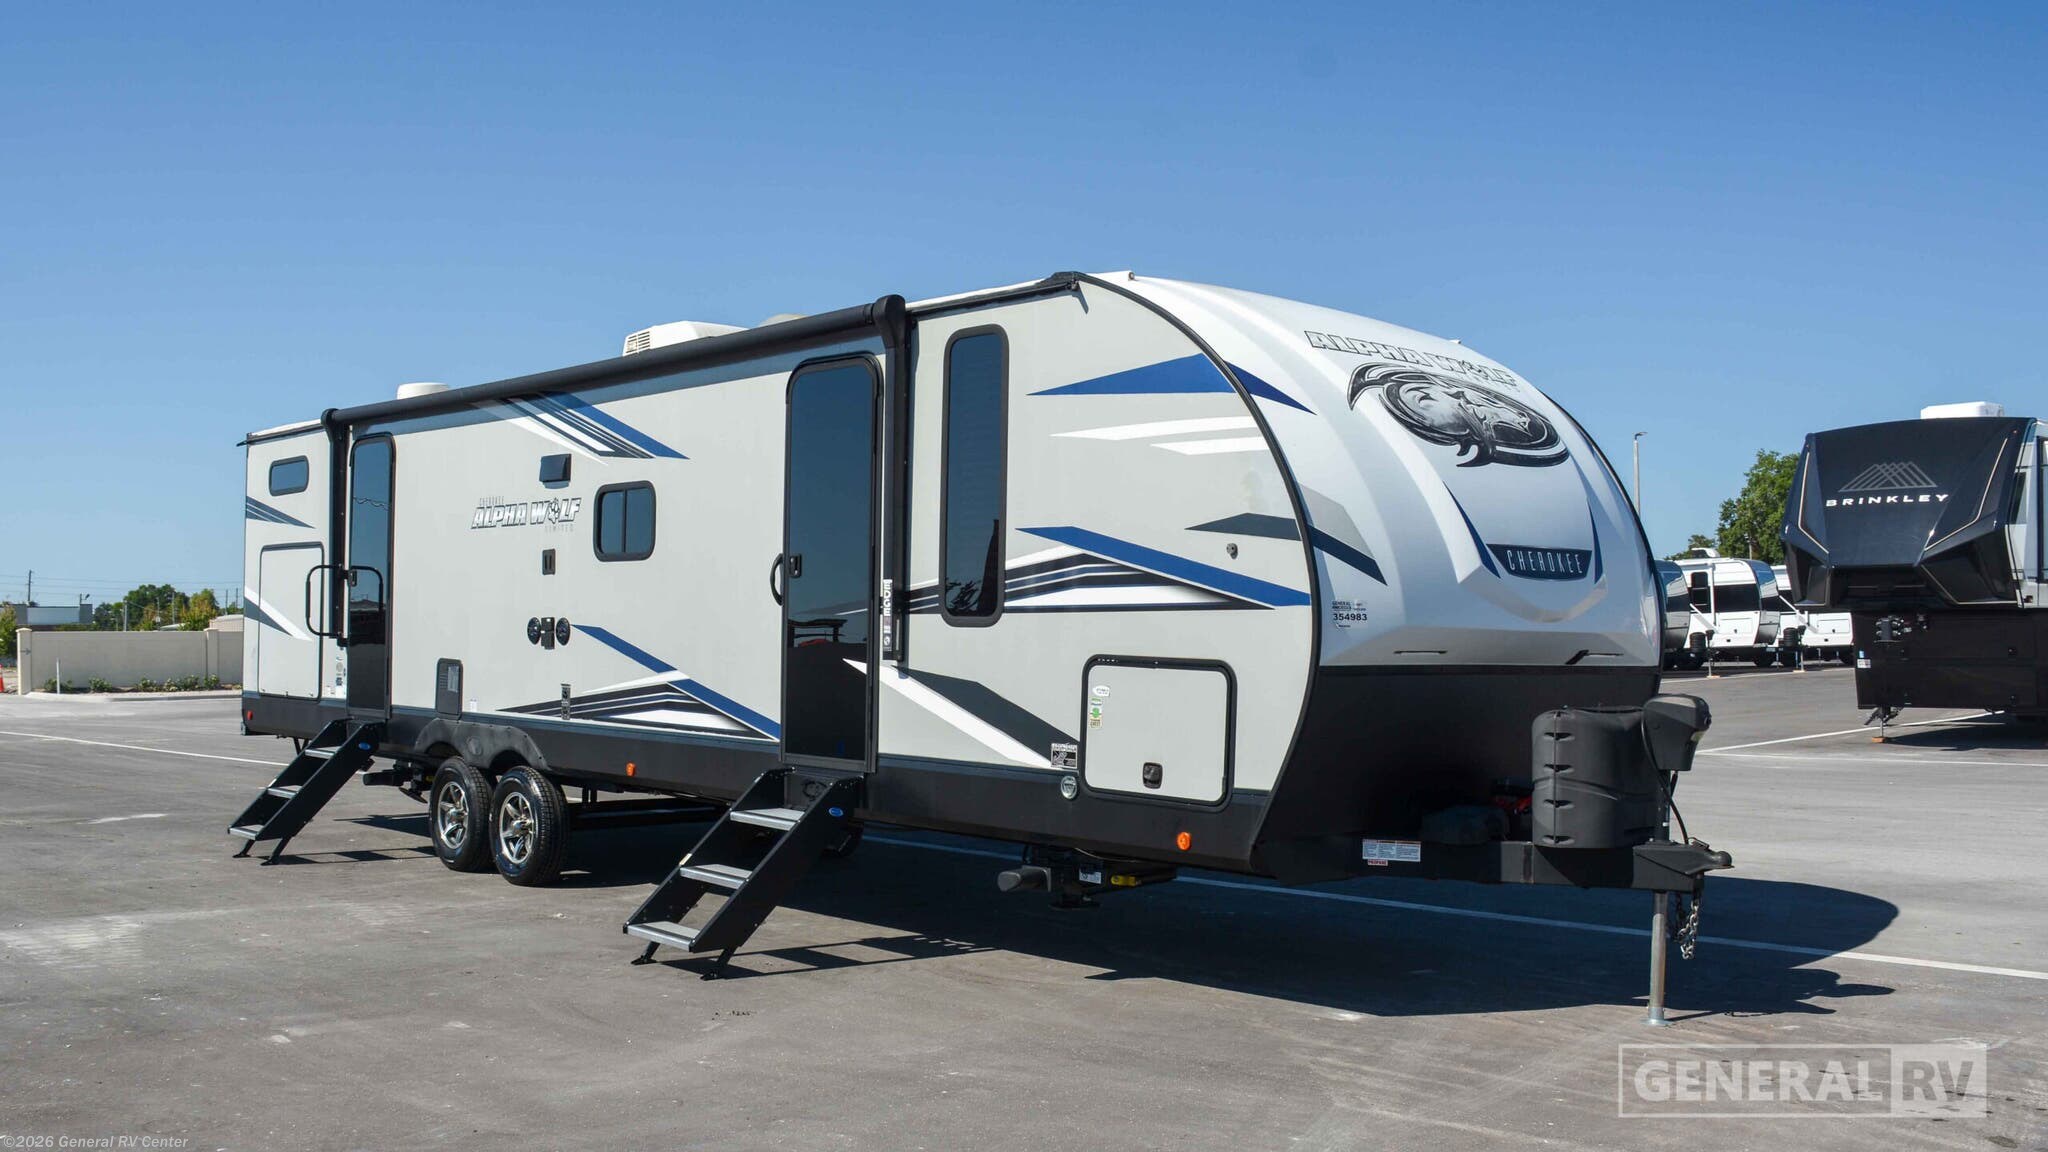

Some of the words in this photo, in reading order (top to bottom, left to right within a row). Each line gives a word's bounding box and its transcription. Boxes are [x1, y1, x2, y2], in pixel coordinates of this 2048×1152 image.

[1304, 330, 1433, 367] ALPHA
[1825, 493, 1949, 507] BRINKLEY
[471, 502, 528, 530] ALPHA
[1506, 549, 1583, 574] CHEROKEE
[1332, 613, 1368, 621] 354983
